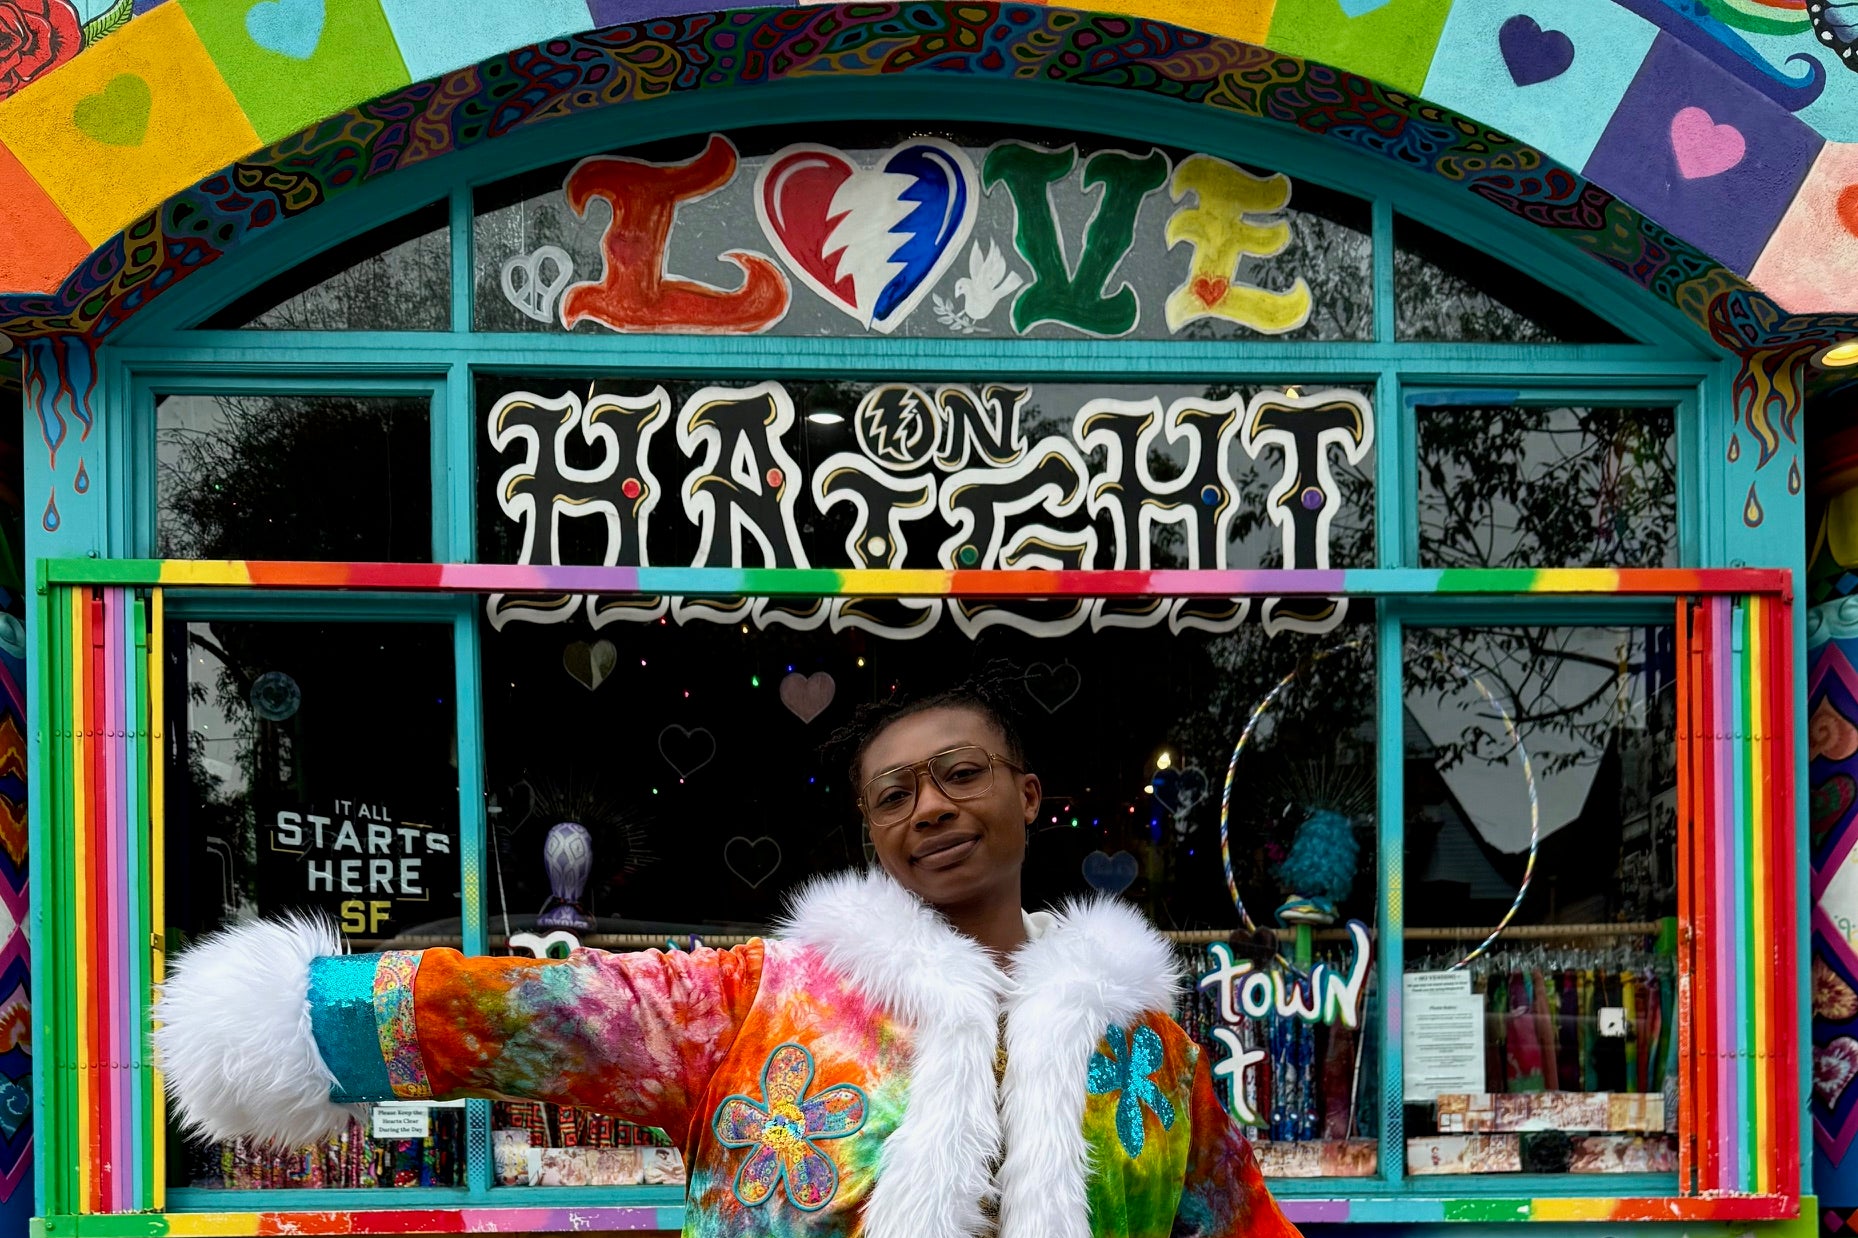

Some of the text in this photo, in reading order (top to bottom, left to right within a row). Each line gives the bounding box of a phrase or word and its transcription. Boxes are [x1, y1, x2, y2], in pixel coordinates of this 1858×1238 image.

[335, 799, 392, 822] IT ALL
[277, 811, 450, 855] STARTS
[308, 858, 423, 895] HERE
[340, 900, 392, 934] SF
